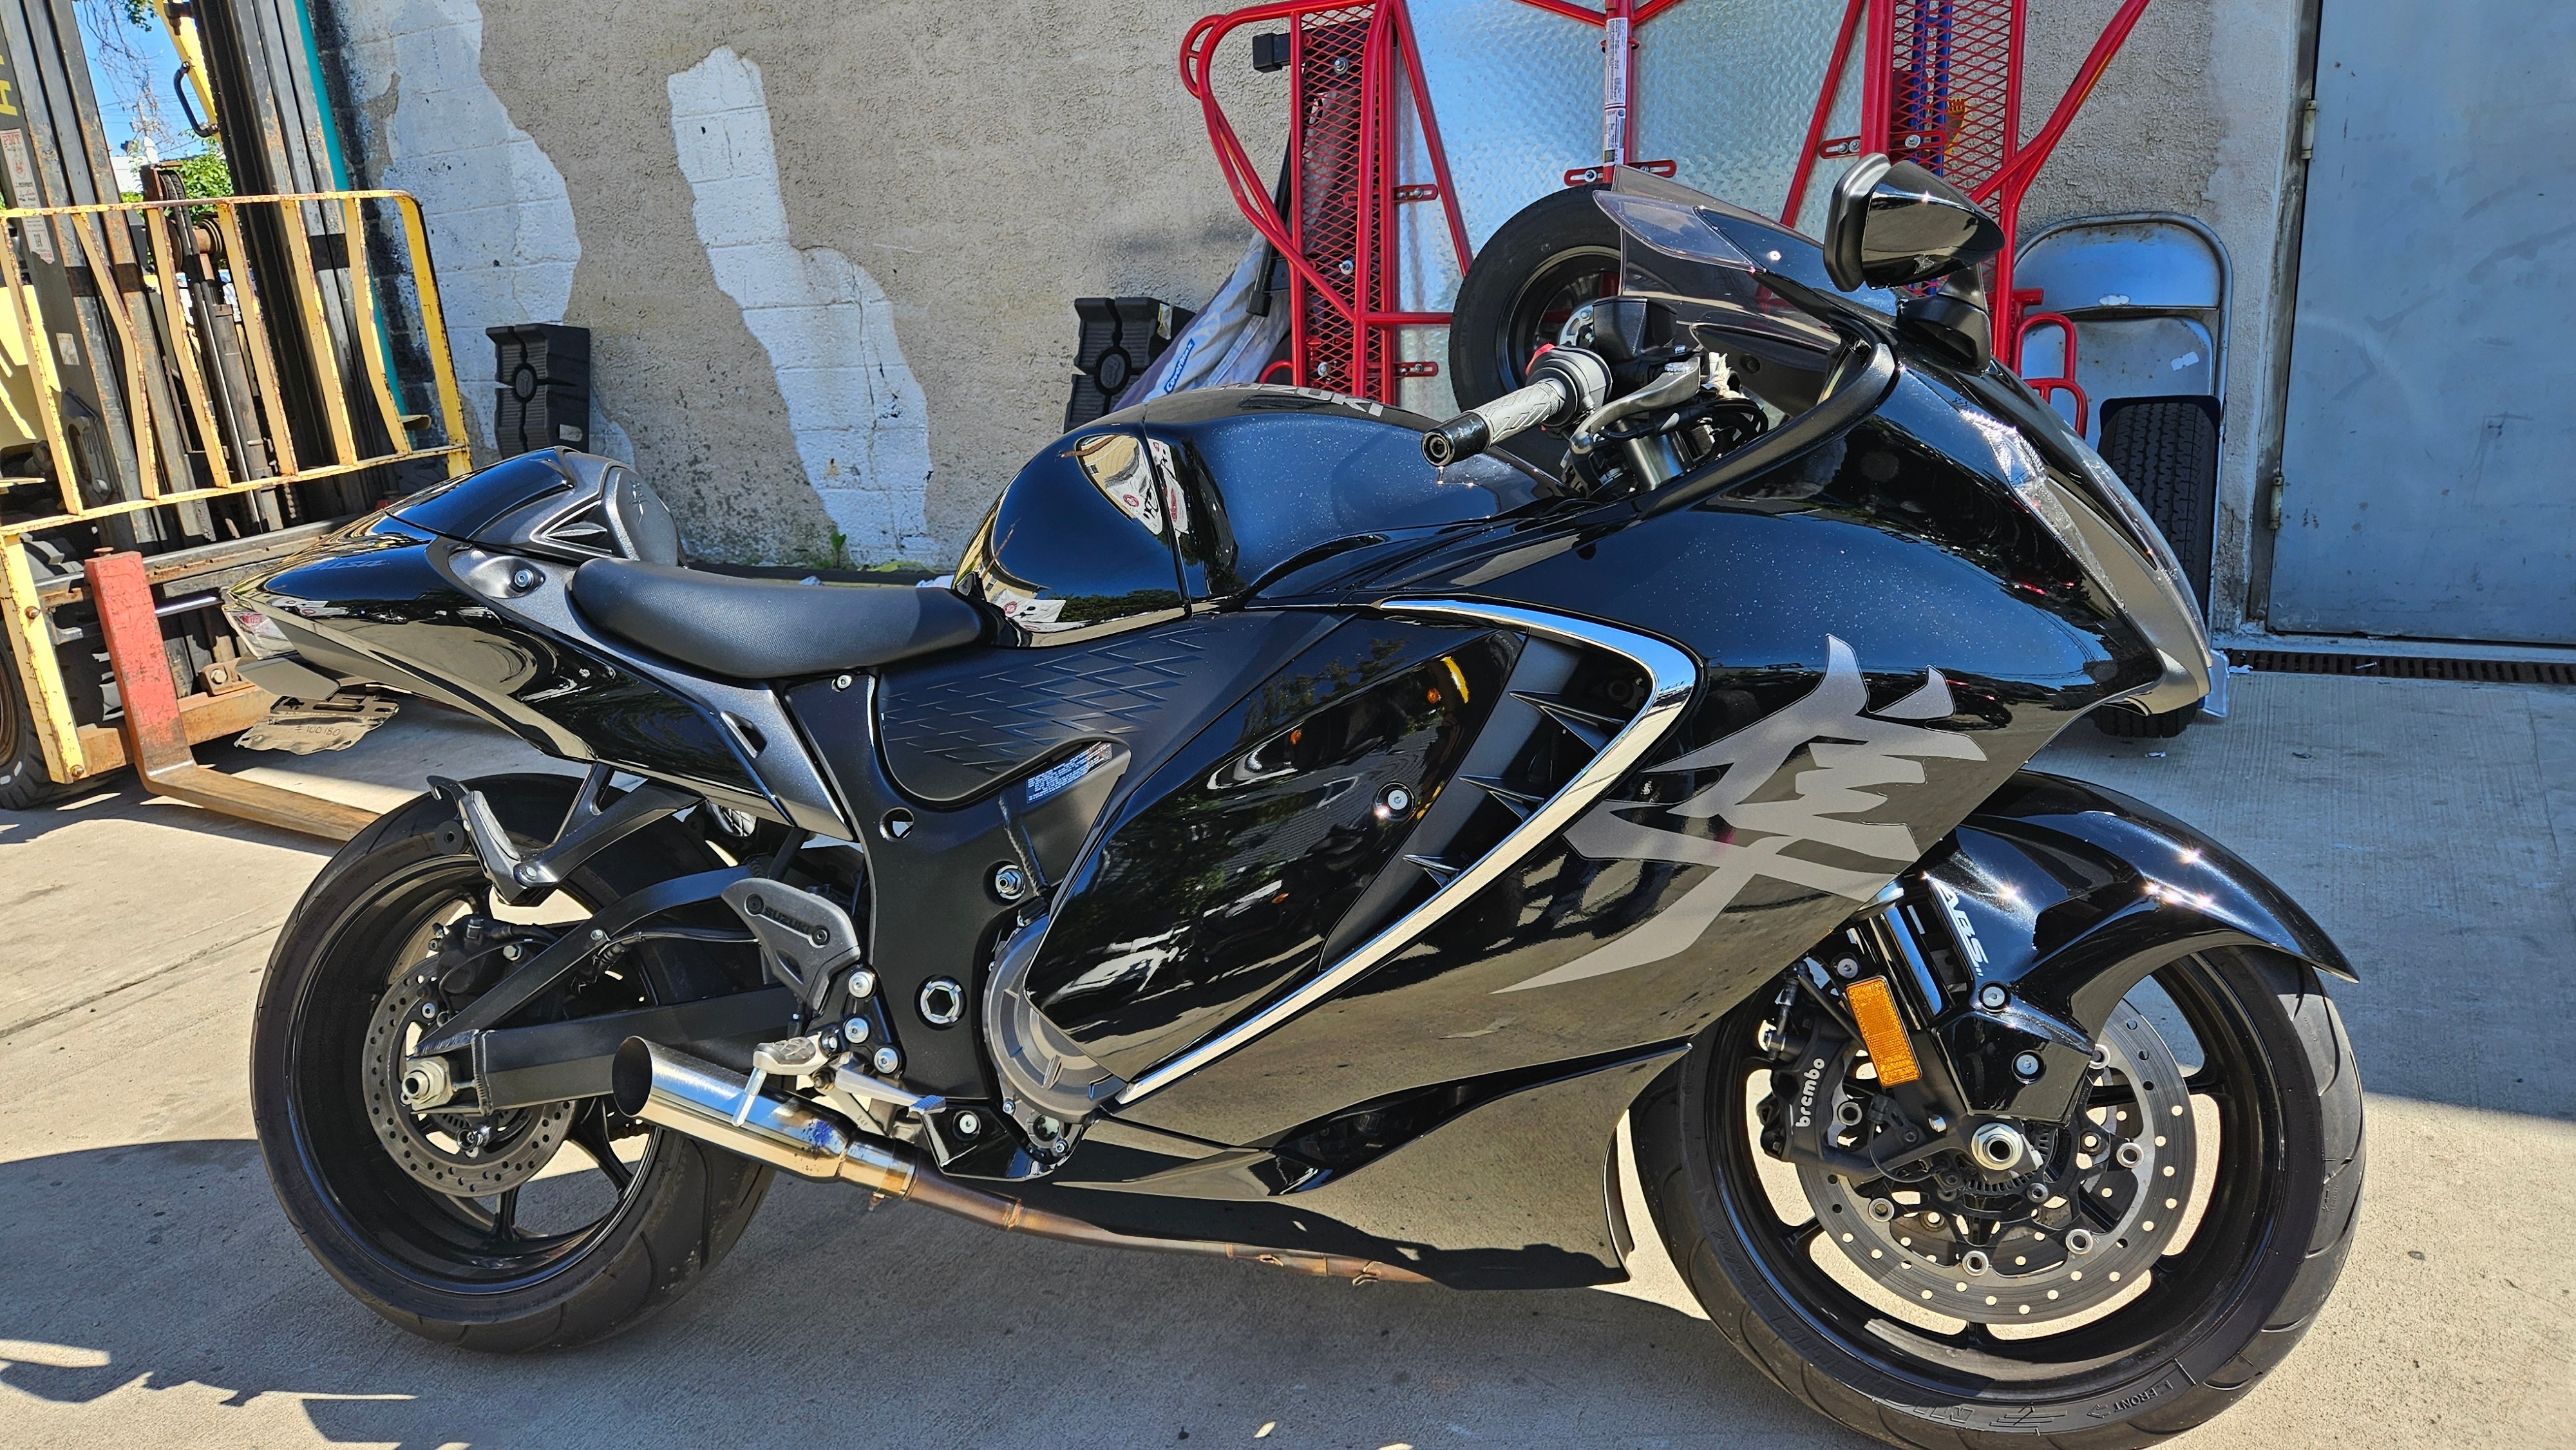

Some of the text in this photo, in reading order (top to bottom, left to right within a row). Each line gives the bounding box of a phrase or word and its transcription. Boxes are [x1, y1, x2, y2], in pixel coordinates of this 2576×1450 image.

[764, 906, 811, 935] SUZUKI
[1932, 880, 1989, 966] ABS
[1795, 1058, 1825, 1127] brembo
[1770, 1315, 1975, 1424] MICHELIN
[2113, 1387, 2160, 1413] FRONT
